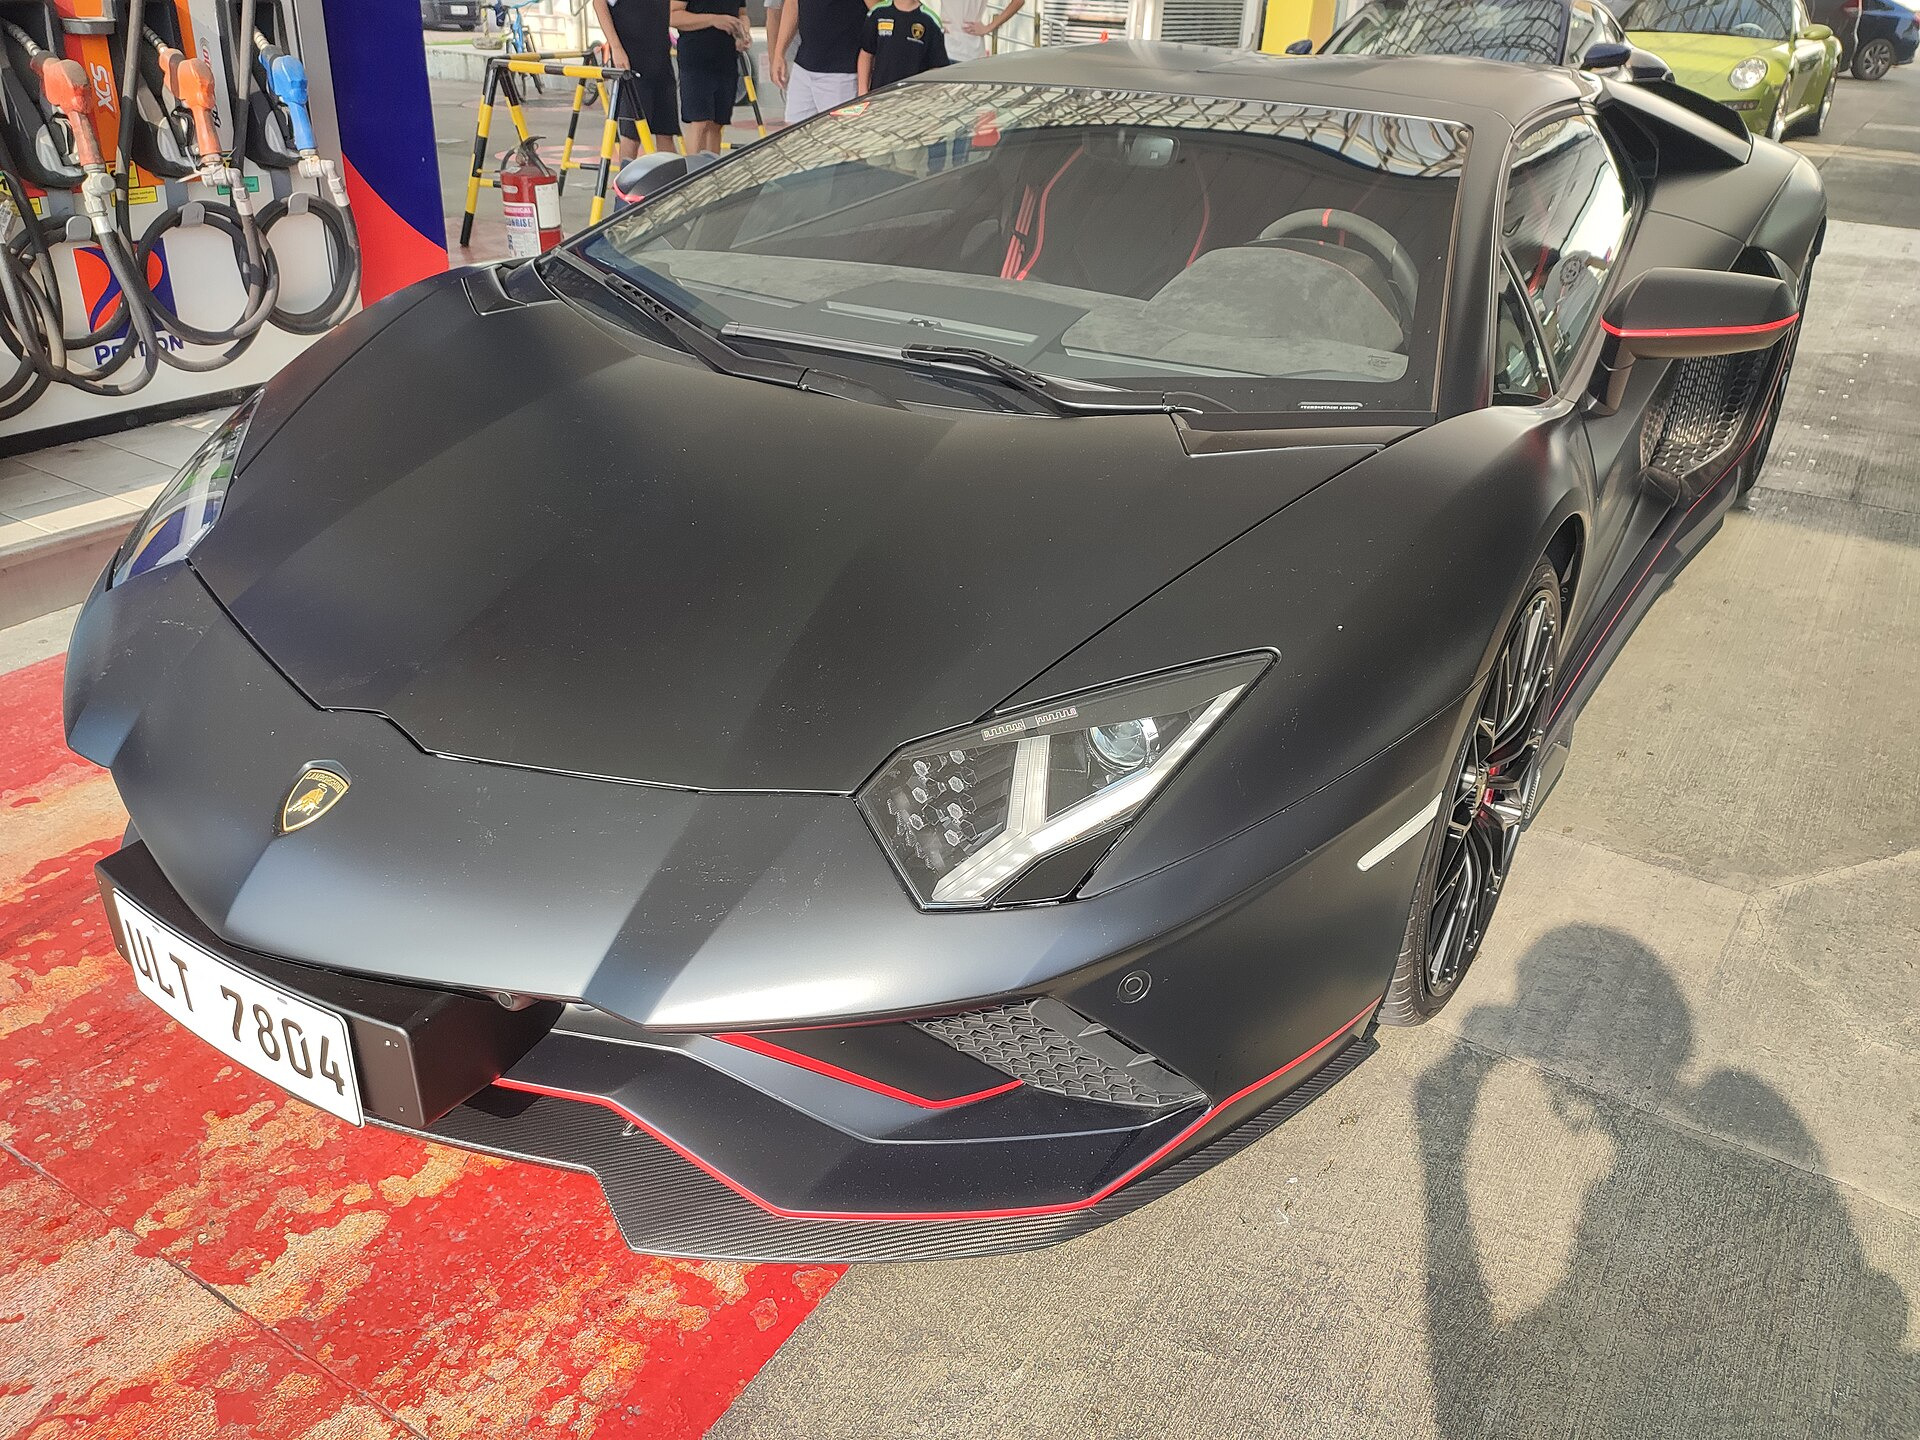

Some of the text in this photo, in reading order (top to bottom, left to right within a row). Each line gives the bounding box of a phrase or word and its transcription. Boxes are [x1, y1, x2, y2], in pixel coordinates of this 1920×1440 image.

[90, 62, 114, 112] XCS
[125, 919, 346, 1096] ULT 7804
